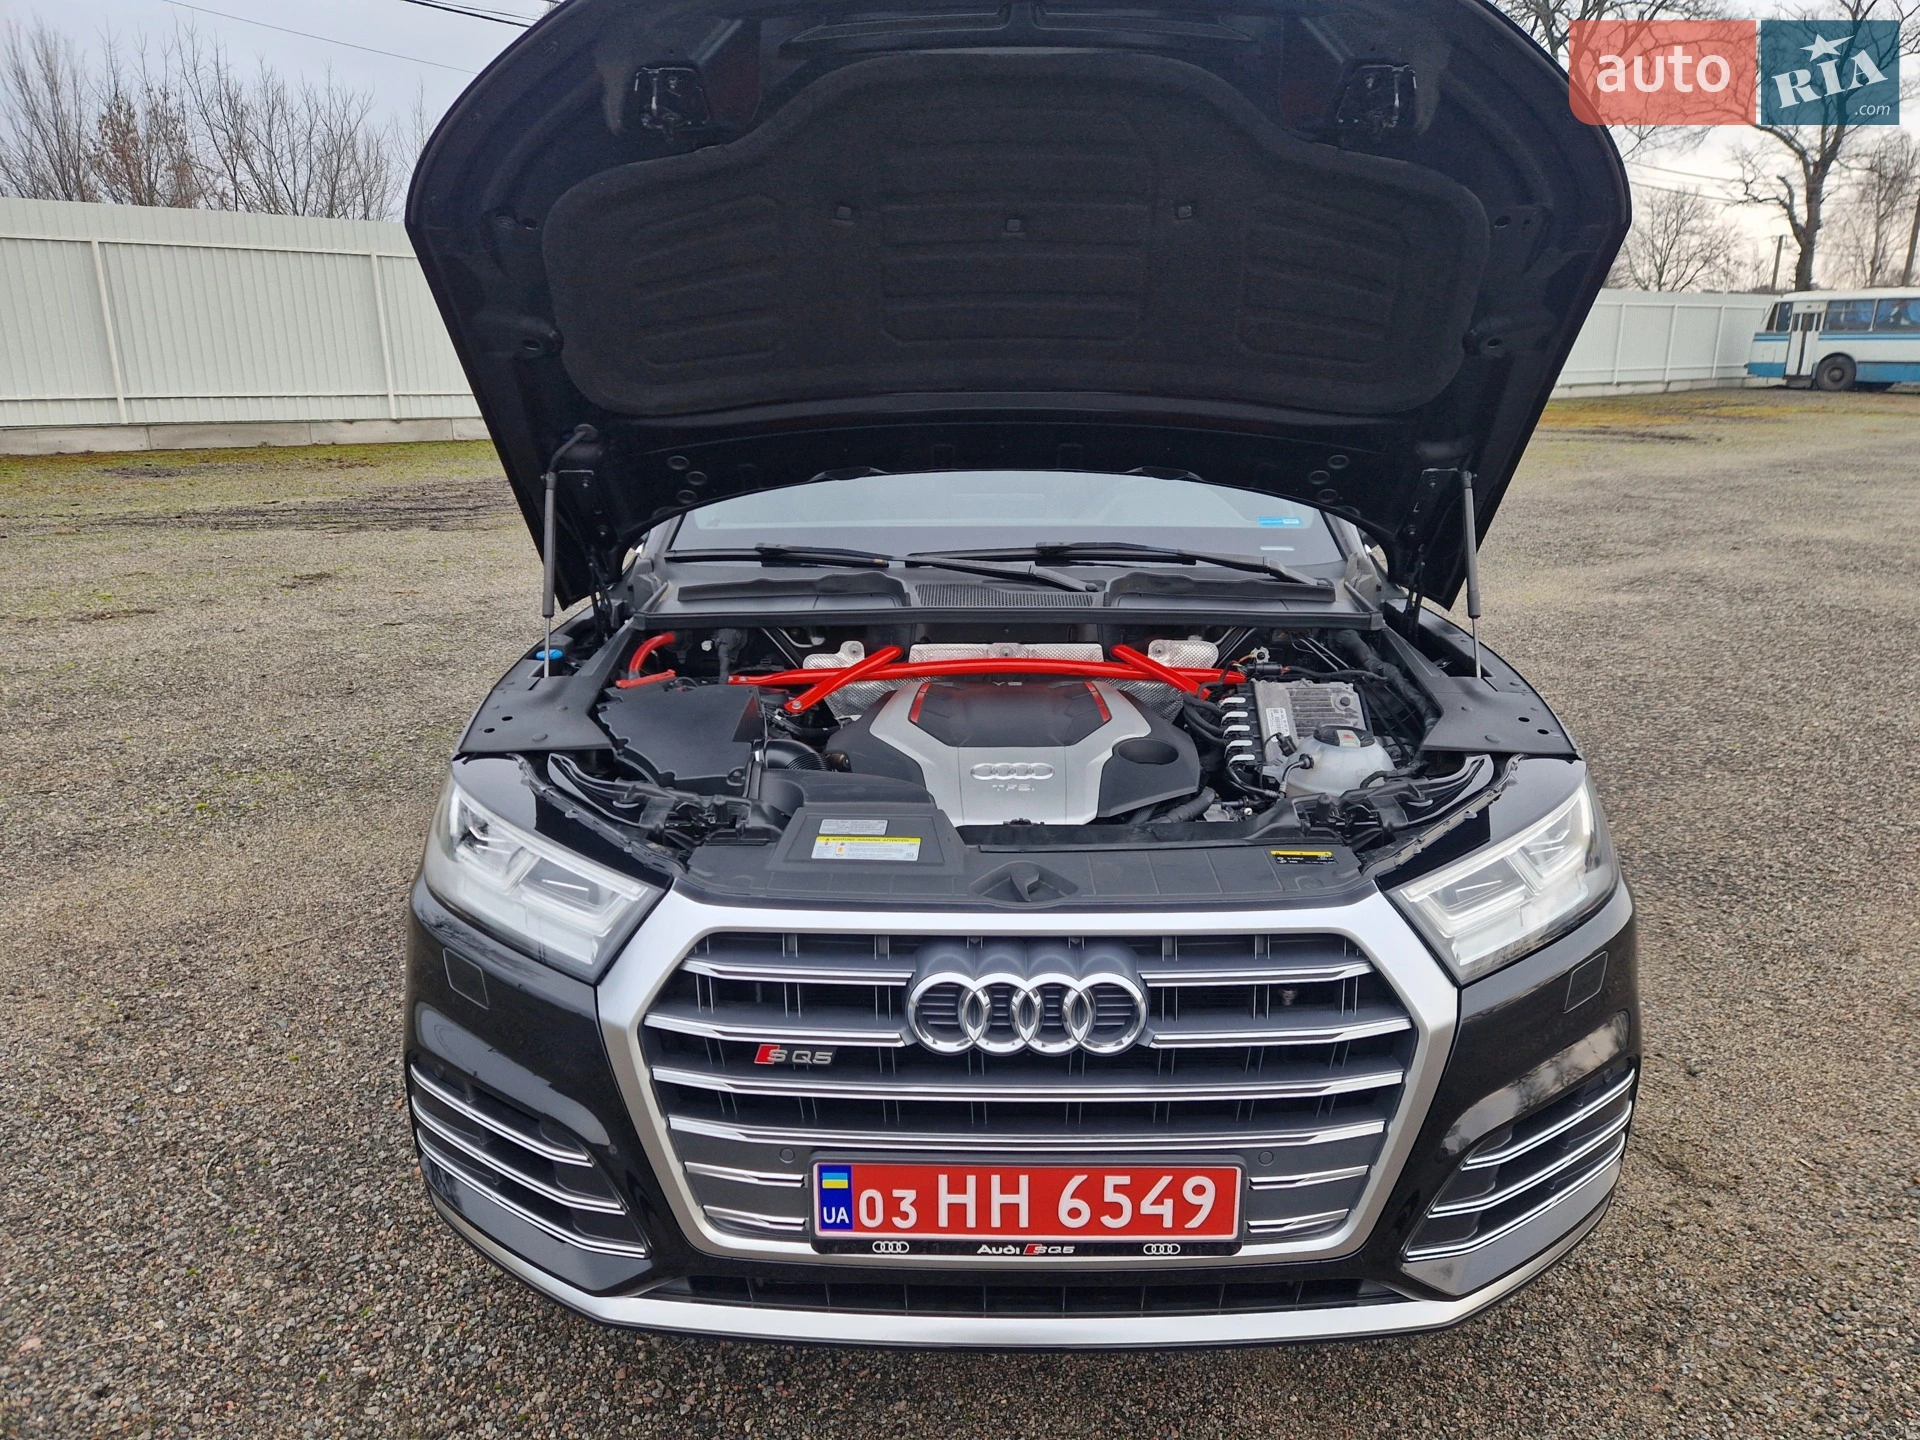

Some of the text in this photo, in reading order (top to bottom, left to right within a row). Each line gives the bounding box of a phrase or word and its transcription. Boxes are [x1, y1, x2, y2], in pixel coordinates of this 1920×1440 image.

[858, 1174, 1218, 1230] 03 HH 6549
[823, 1207, 850, 1225] UA
[976, 1244, 1020, 1255] Audi
